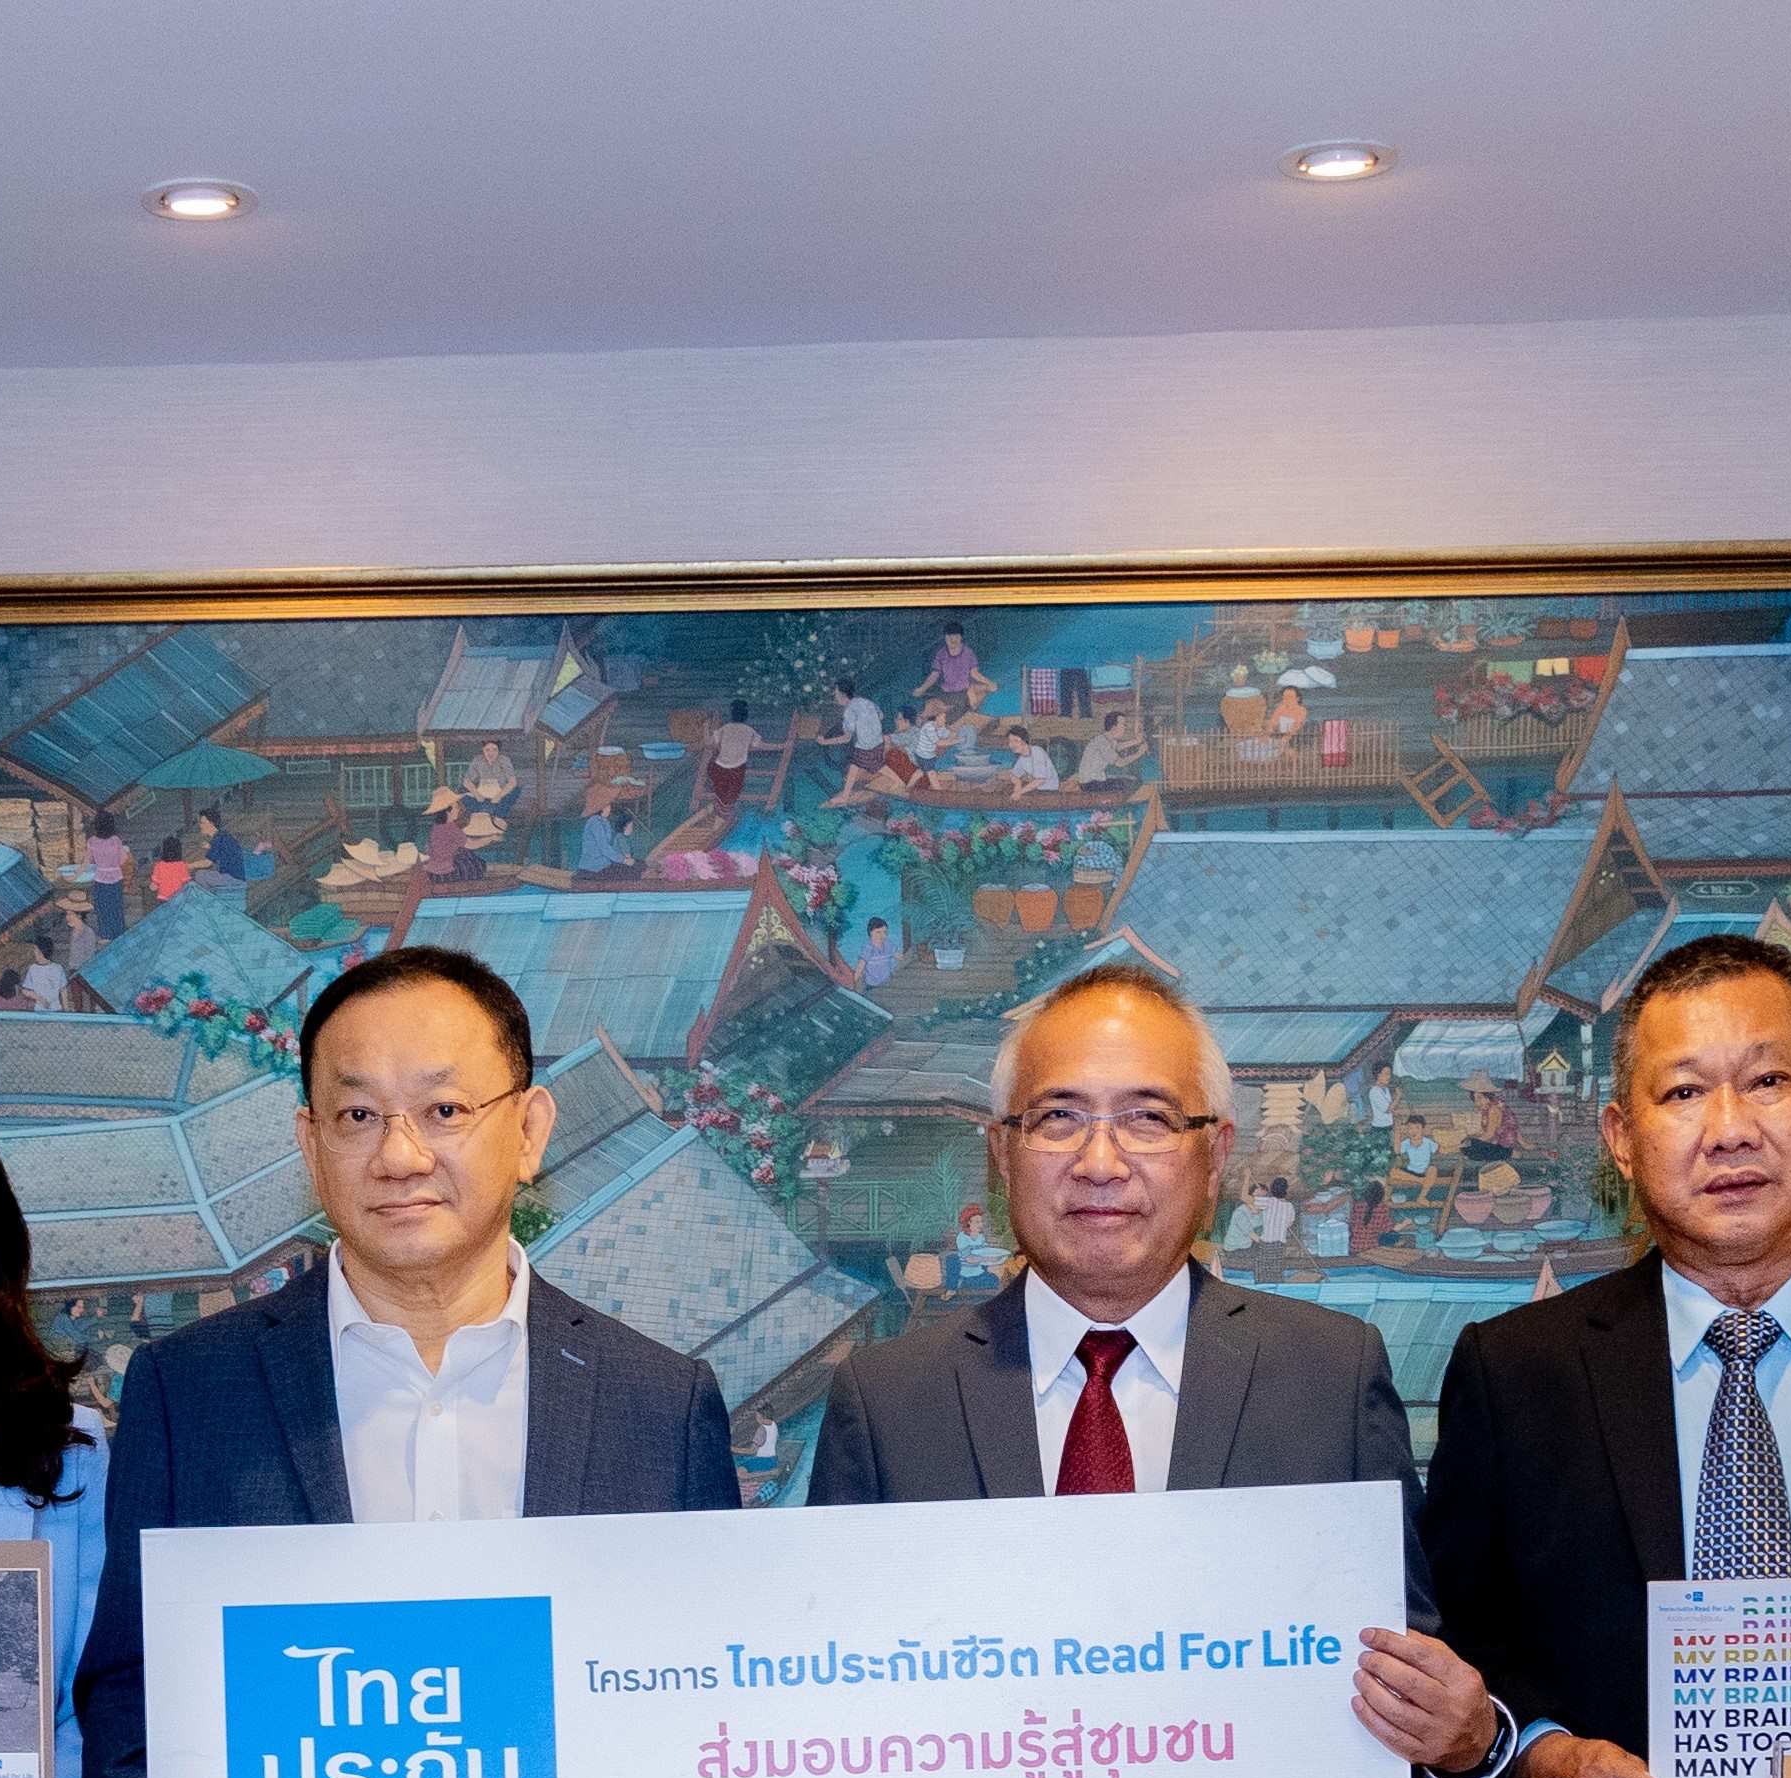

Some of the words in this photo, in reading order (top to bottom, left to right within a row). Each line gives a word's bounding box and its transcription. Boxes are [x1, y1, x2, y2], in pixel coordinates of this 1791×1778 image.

[586, 1660, 719, 1693] โครงการ
[725, 1634, 1039, 1687] ไทยประกันชีวิต
[1054, 1631, 1165, 1675] Read
[1179, 1632, 1253, 1670] For
[1262, 1624, 1342, 1667] Life
[282, 1645, 461, 1727] ไทย
[1674, 1710, 1716, 1729] MY
[1674, 1734, 1728, 1753] HAS
[1674, 1758, 1757, 1777] MANY
